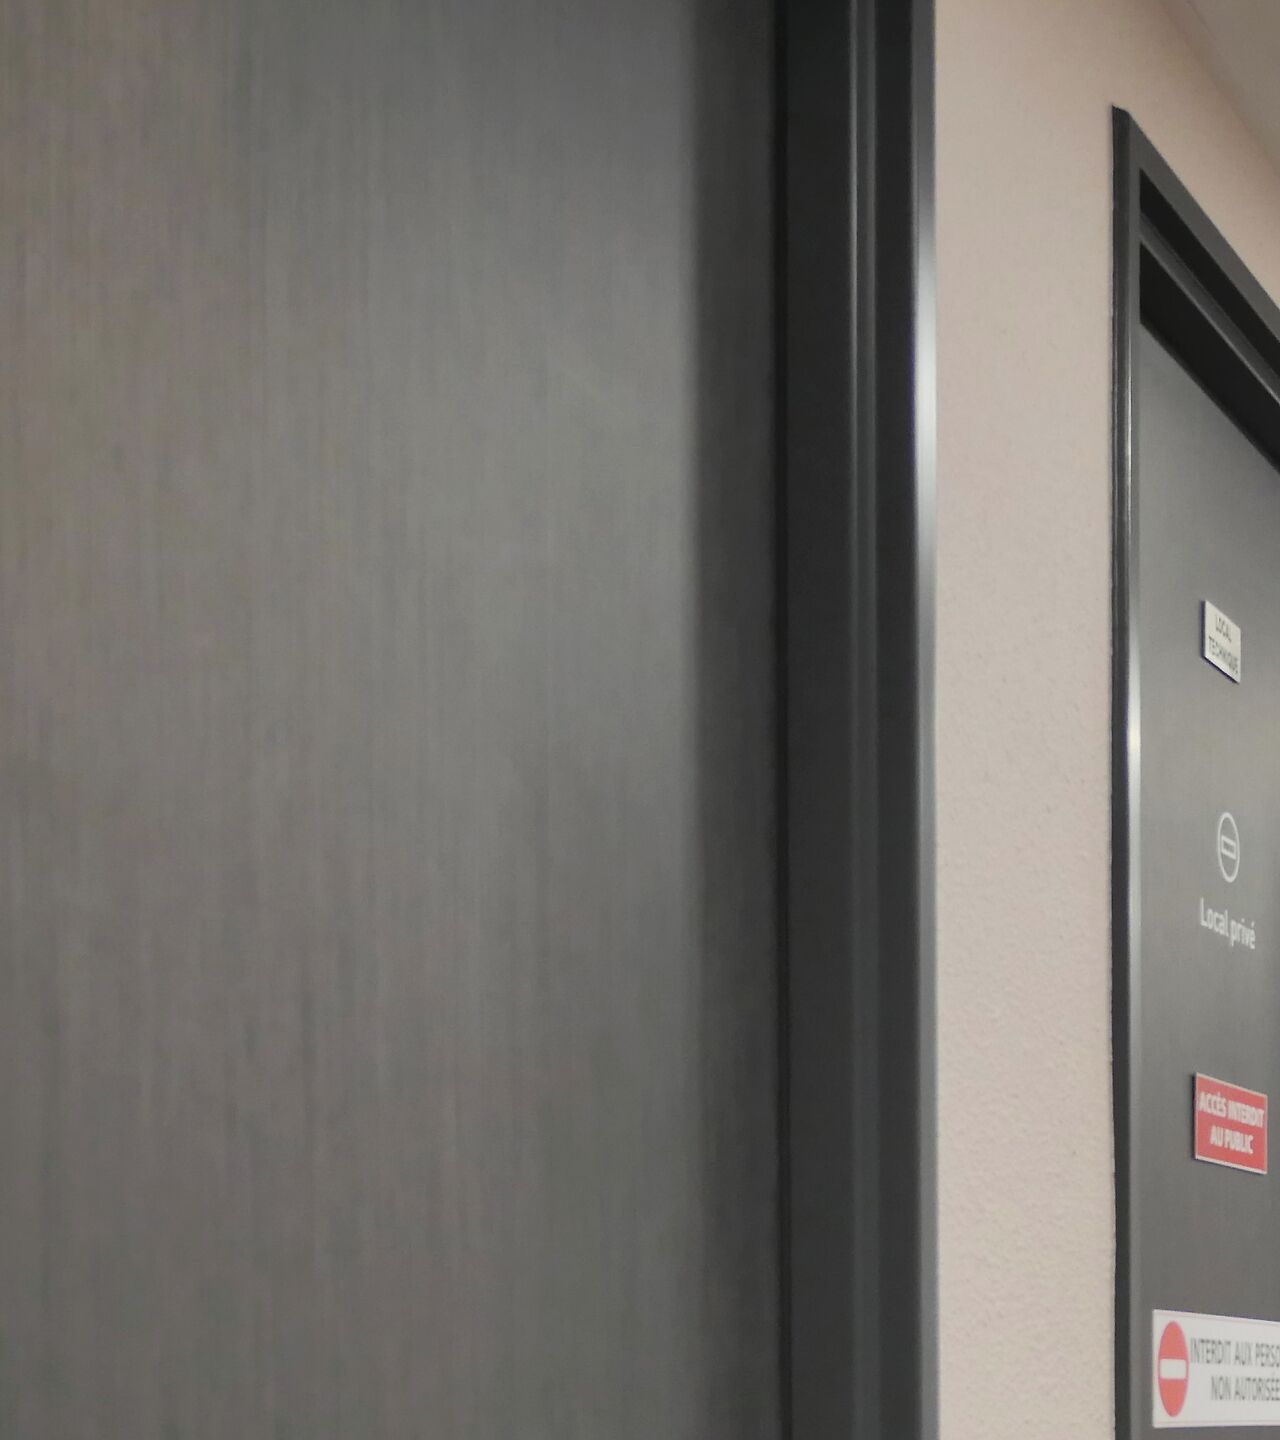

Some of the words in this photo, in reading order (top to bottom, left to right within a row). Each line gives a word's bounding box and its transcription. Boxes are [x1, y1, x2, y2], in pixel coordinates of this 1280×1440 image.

[1200, 896, 1229, 937] Local
[1230, 918, 1256, 949] privé
[1199, 1090, 1227, 1118] ACCÈS
[1227, 1099, 1264, 1129] INTERDIT
[1209, 1125, 1224, 1148] AU
[1224, 1128, 1255, 1155] PUBLIC
[1190, 1337, 1231, 1364] INTERDIT
[1233, 1341, 1253, 1366] AUX
[1211, 1375, 1232, 1401] NON
